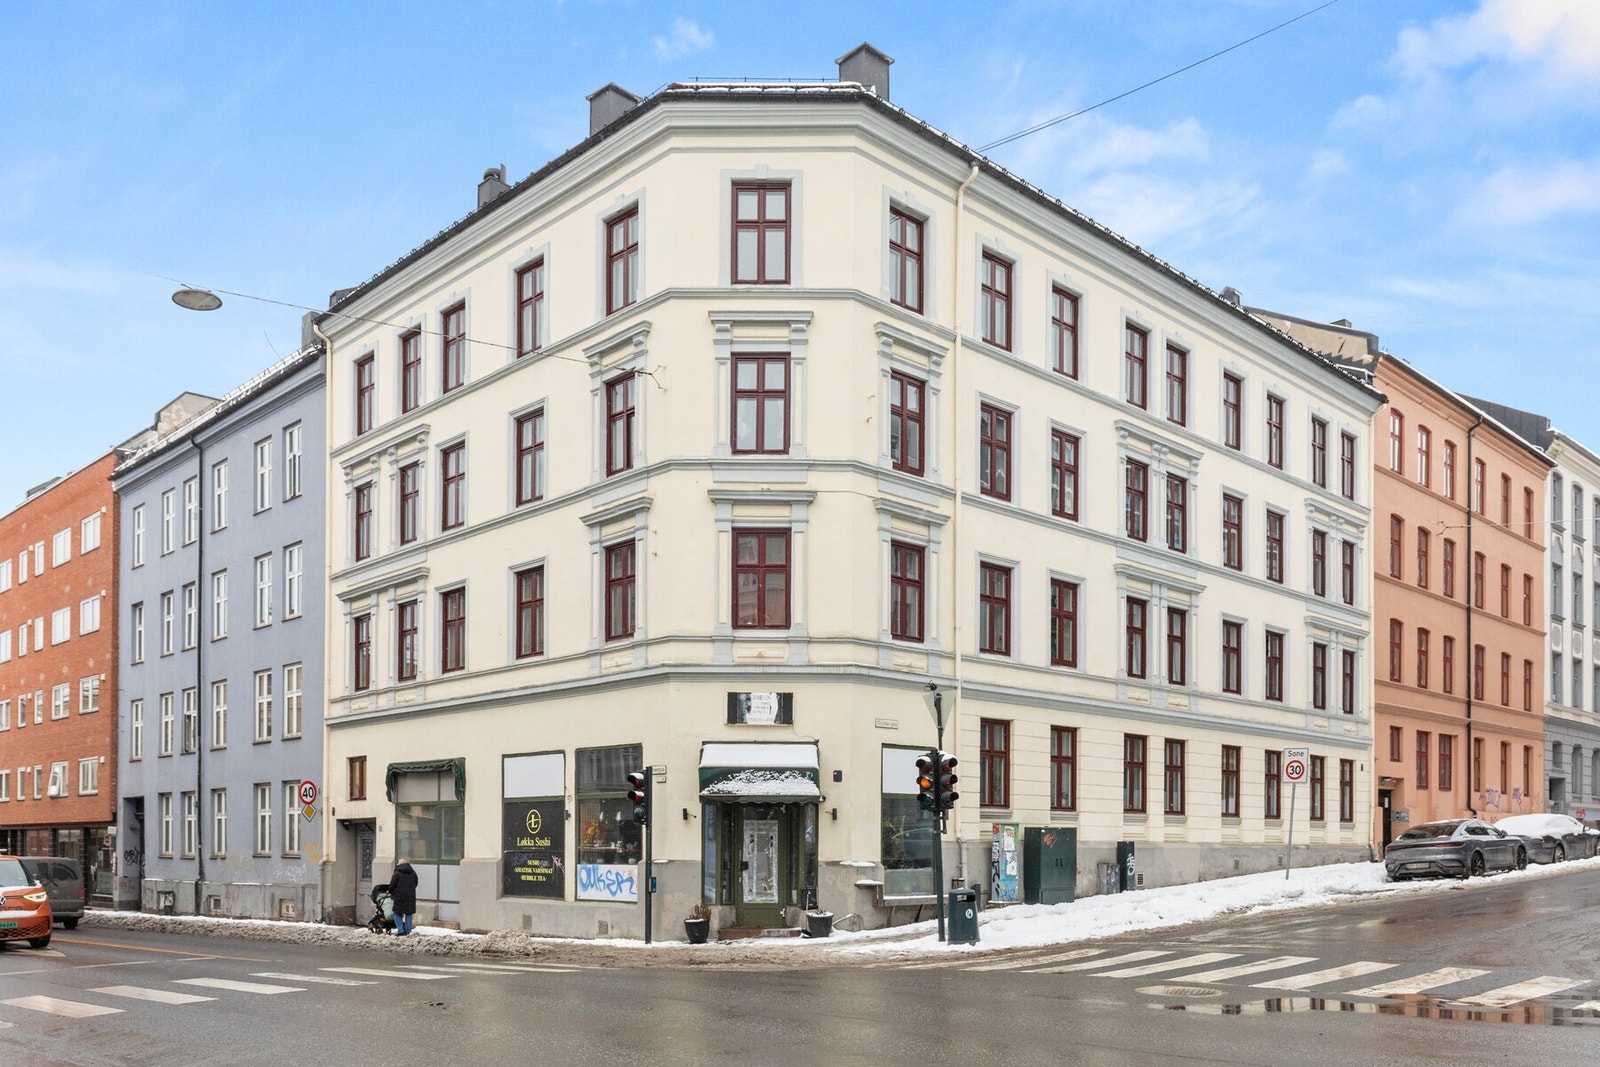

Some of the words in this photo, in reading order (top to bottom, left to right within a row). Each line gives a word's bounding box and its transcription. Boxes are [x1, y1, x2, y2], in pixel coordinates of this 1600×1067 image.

[1289, 765, 1301, 775] 30
[303, 786, 314, 798] 40
[535, 837, 551, 846] Sushi
